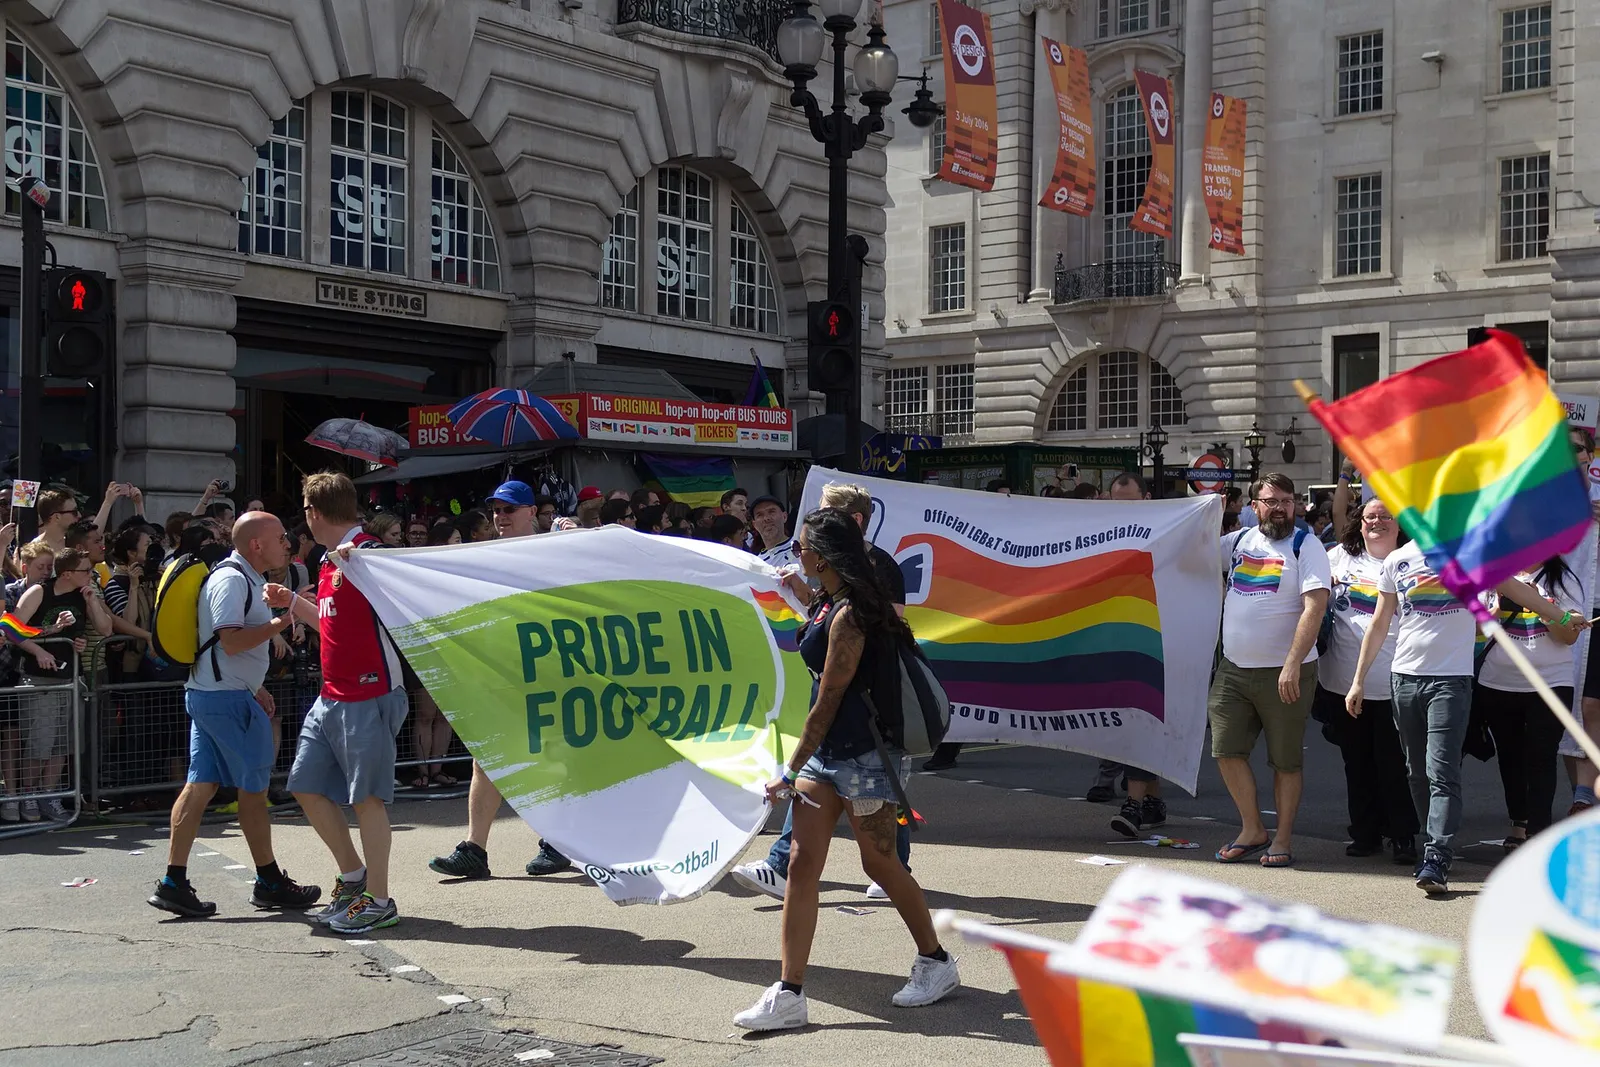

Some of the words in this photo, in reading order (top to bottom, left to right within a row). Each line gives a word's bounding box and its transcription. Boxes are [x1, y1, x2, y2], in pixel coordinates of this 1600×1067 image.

[961, 45, 987, 57] DESIGN
[955, 110, 960, 120] 3
[961, 113, 974, 127] July
[974, 117, 989, 131] 2016
[1060, 111, 1092, 135] TRANSPORTED
[1061, 124, 1068, 134] BY
[1068, 127, 1085, 144] DESIGN
[1061, 136, 1085, 159] Festival
[1204, 175, 1214, 184] BY
[321, 284, 358, 302] THE
[364, 290, 422, 311] STING
[592, 396, 611, 412] The
[614, 398, 663, 415] ORIGINAL
[665, 402, 699, 420] hop-on
[702, 405, 736, 422] hop-off
[738, 408, 756, 422] BUS
[758, 410, 787, 424] TOURS
[1576, 403, 1586, 413] IN
[418, 427, 449, 445] BUS
[697, 425, 734, 438] TICKETS
[919, 456, 944, 464] ICE
[949, 453, 1005, 464] CREAM
[1034, 453, 1083, 463] TRADITIONAL
[1099, 456, 1123, 465] CREAM
[963, 471, 976, 480] ICE
[1186, 471, 1232, 479] UNDERGROUND
[924, 508, 969, 534] Official
[967, 525, 1003, 550] LGB&T
[1001, 538, 1072, 559] Supporters
[1075, 523, 1152, 550] Association
[516, 611, 670, 683] PRIDE
[678, 608, 732, 673] IN
[525, 682, 759, 754] FOOTBALL
[949, 704, 999, 725] ROUD
[1010, 711, 1123, 731] LILYWHITES
